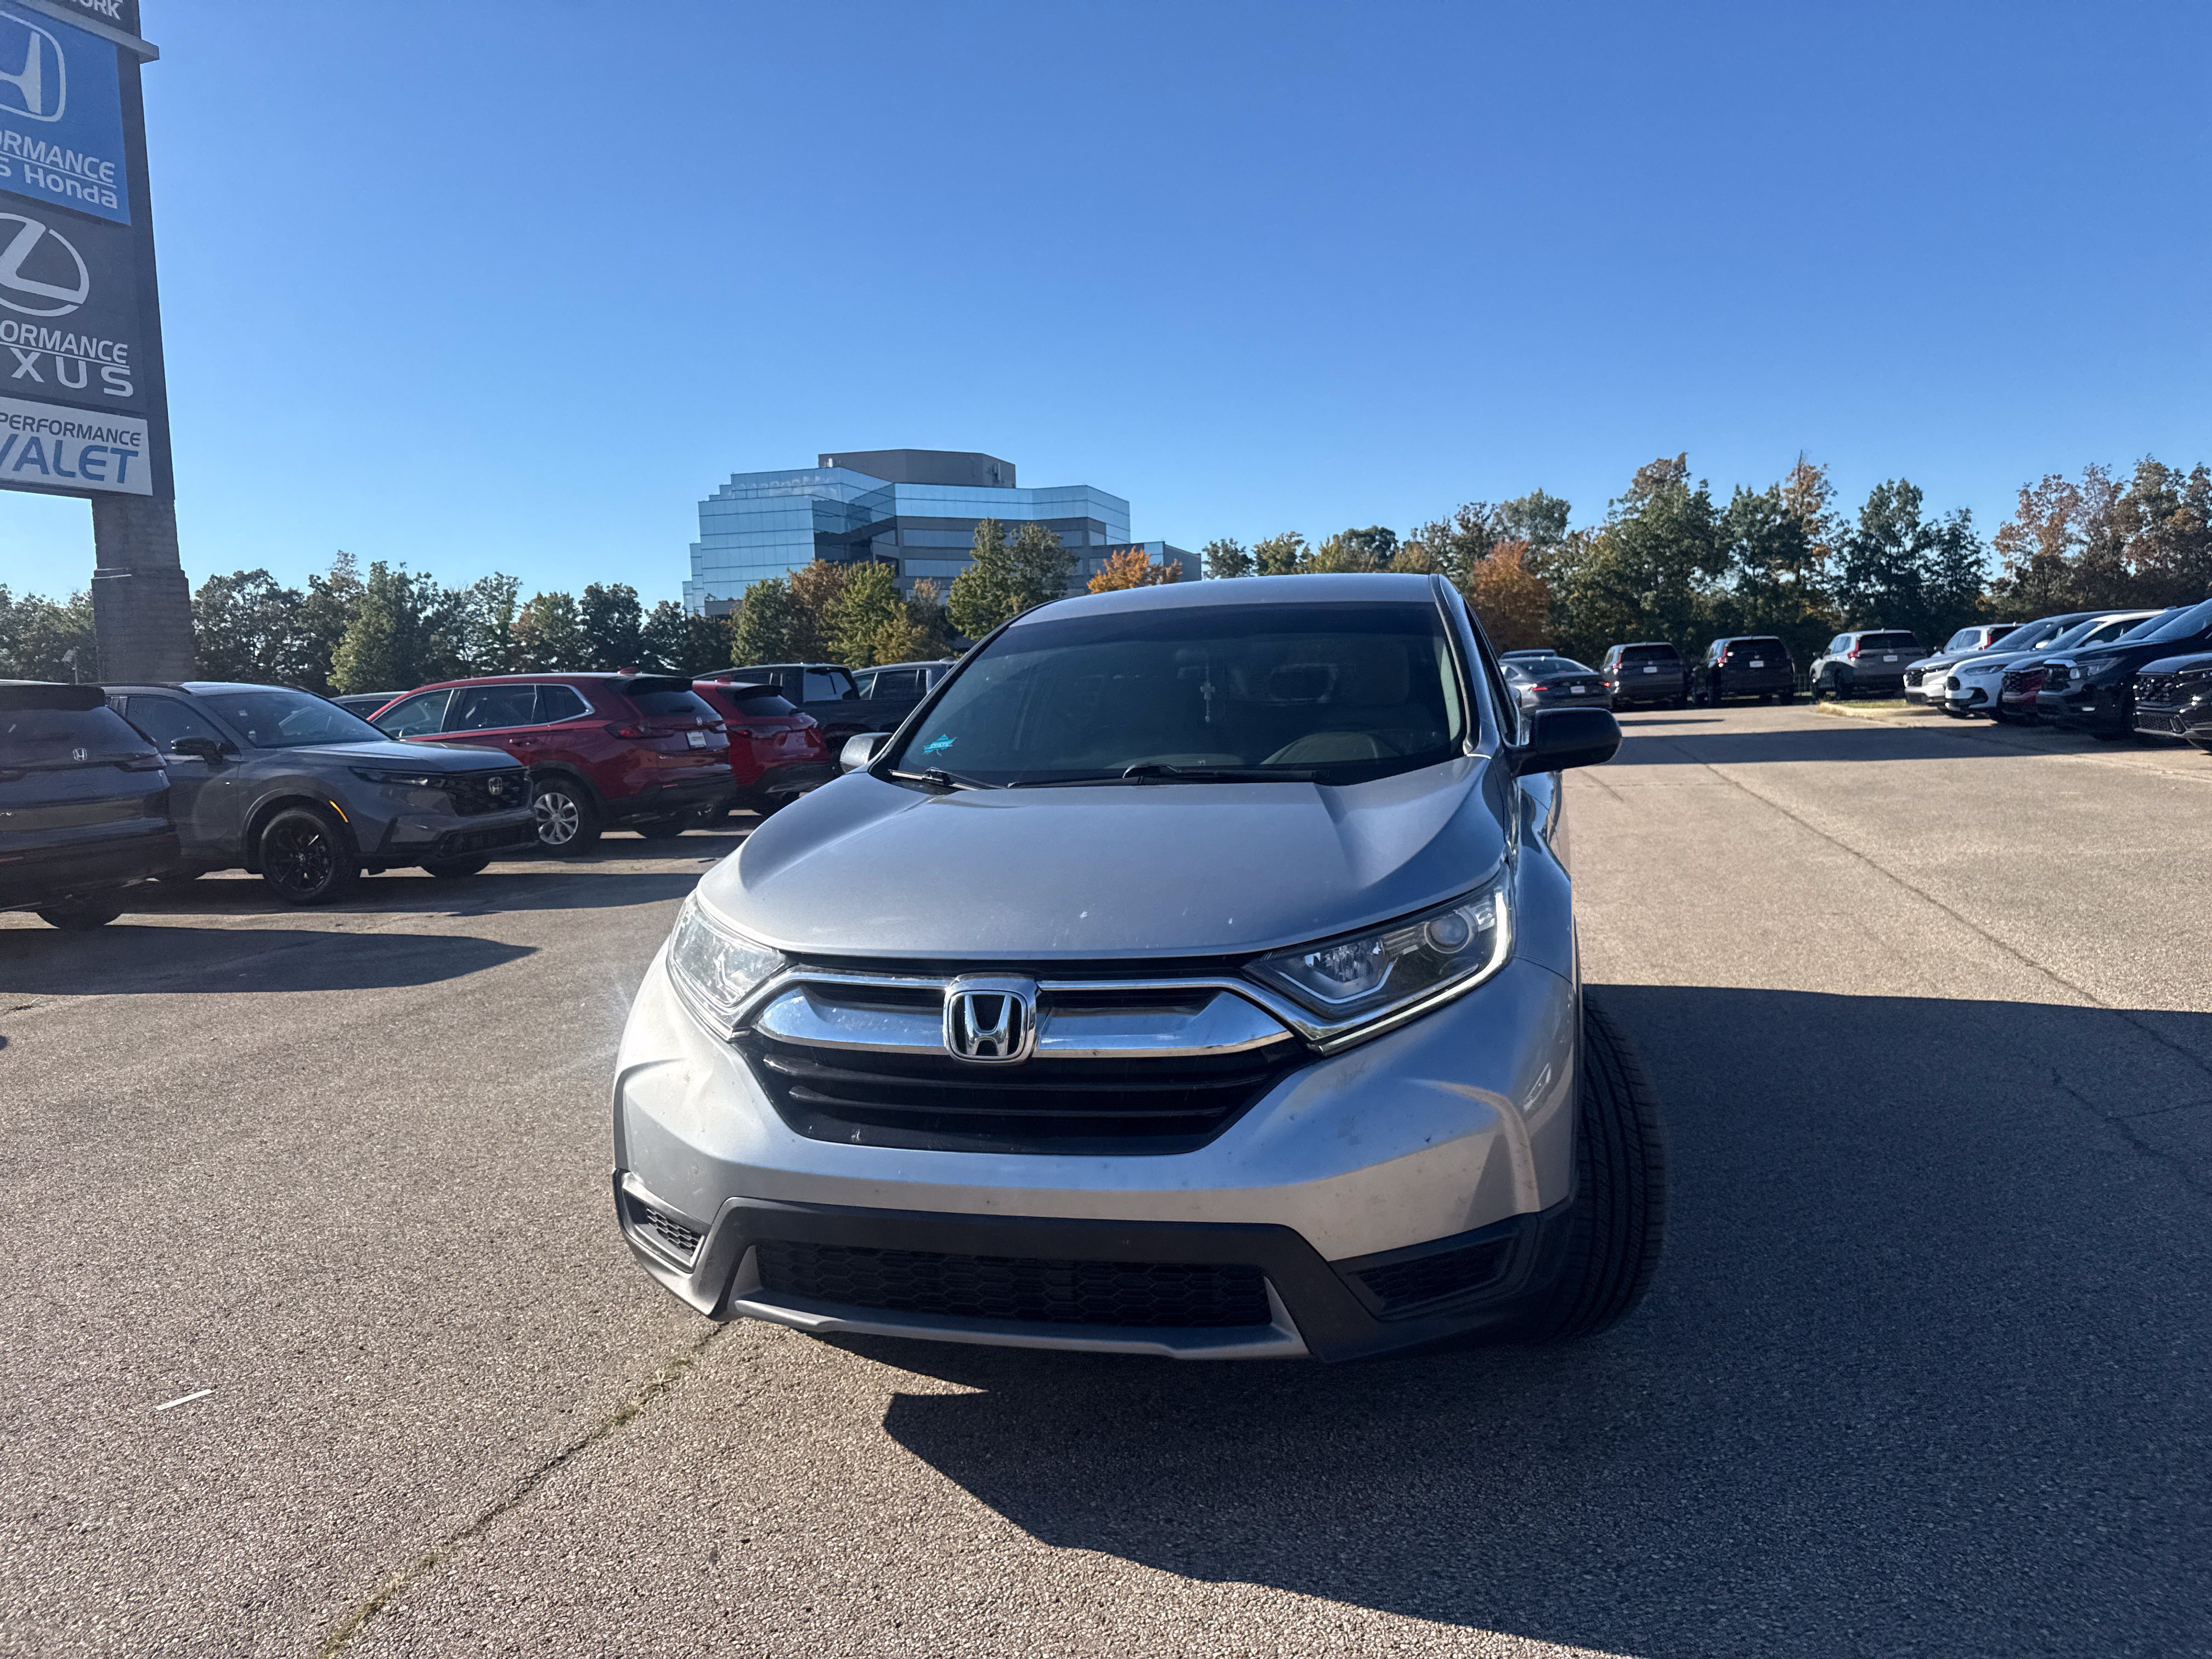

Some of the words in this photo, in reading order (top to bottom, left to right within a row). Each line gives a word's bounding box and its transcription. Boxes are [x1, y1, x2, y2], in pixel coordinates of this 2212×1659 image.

[0, 129, 115, 184] RMANCE
[24, 163, 118, 209] Honda
[0, 320, 128, 364] ORMANCE
[9, 347, 133, 398] XUS
[0, 412, 141, 447] PERFORMANCE
